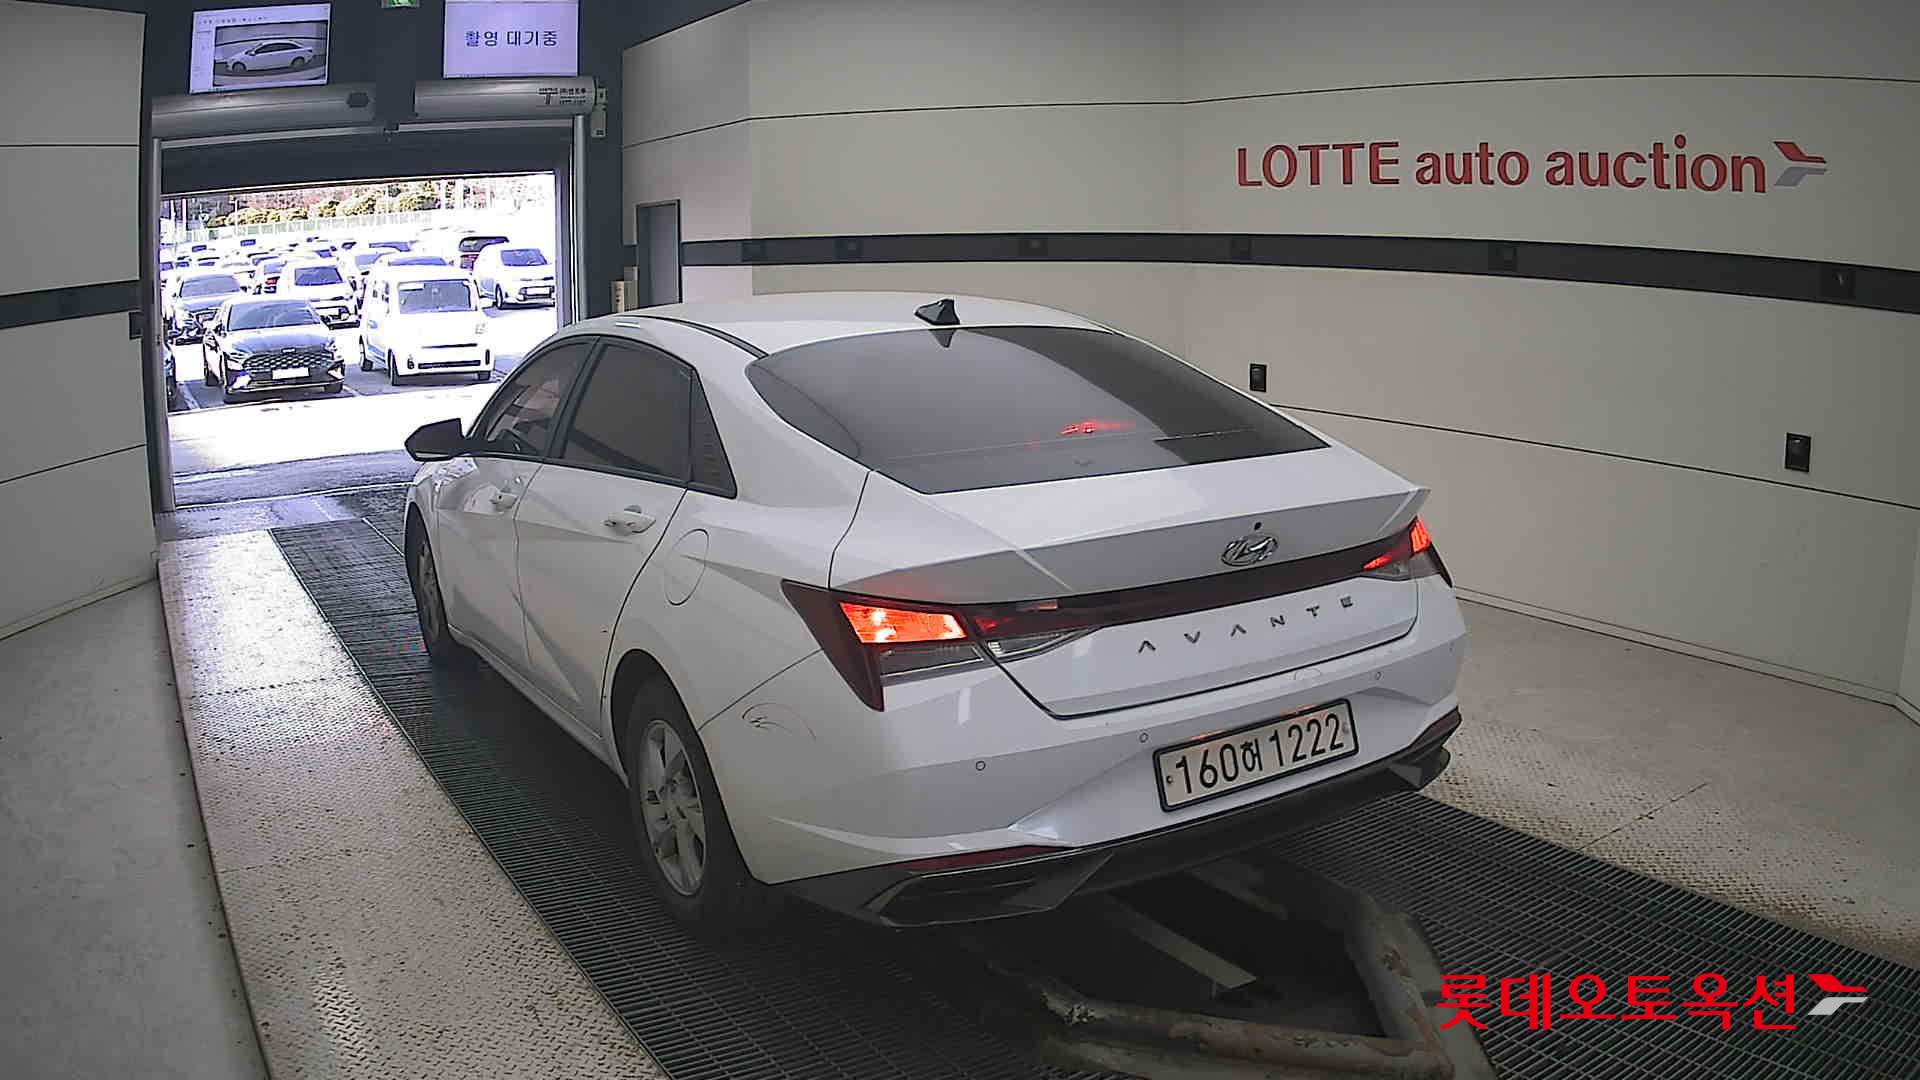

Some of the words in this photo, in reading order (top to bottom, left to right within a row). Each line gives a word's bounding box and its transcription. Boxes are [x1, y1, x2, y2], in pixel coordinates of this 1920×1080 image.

[506, 30, 557, 47] 대기중
[1237, 142, 1400, 187] LOTTE
[1416, 143, 1529, 187] auto
[1545, 135, 1766, 194] auction
[1138, 596, 1354, 653] AVANTE
[1175, 738, 1263, 795] 160허
[1269, 713, 1345, 767] 1222
